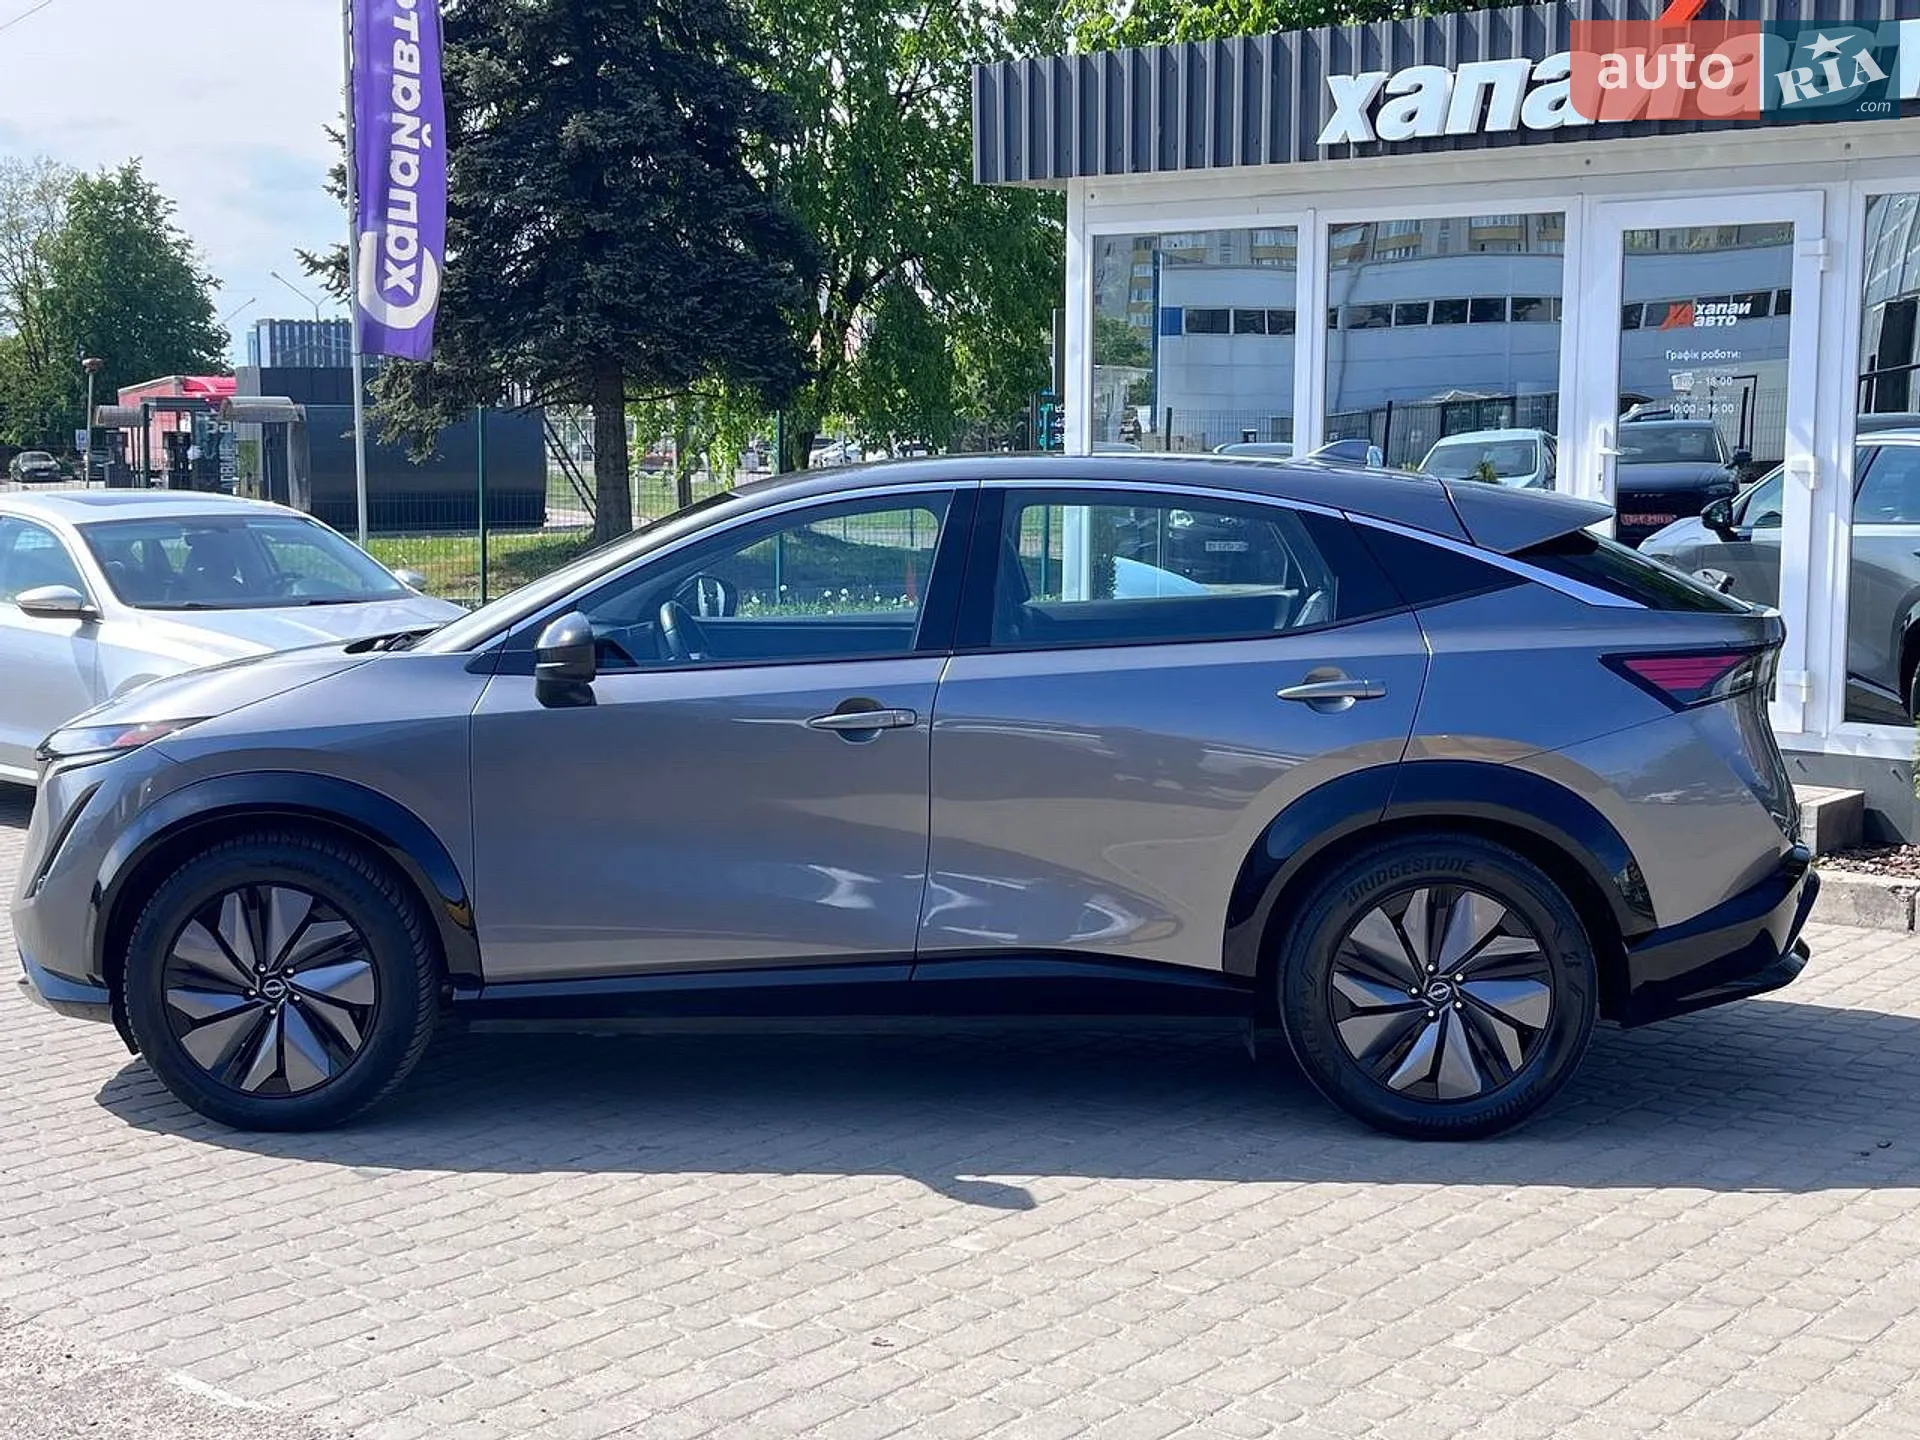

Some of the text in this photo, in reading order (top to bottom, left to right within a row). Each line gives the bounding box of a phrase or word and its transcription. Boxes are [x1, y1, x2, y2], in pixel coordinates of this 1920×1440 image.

[1693, 314, 1737, 328] авто
[1666, 348, 1700, 361] Графік
[1343, 857, 1475, 906] BRIDGESTONE
